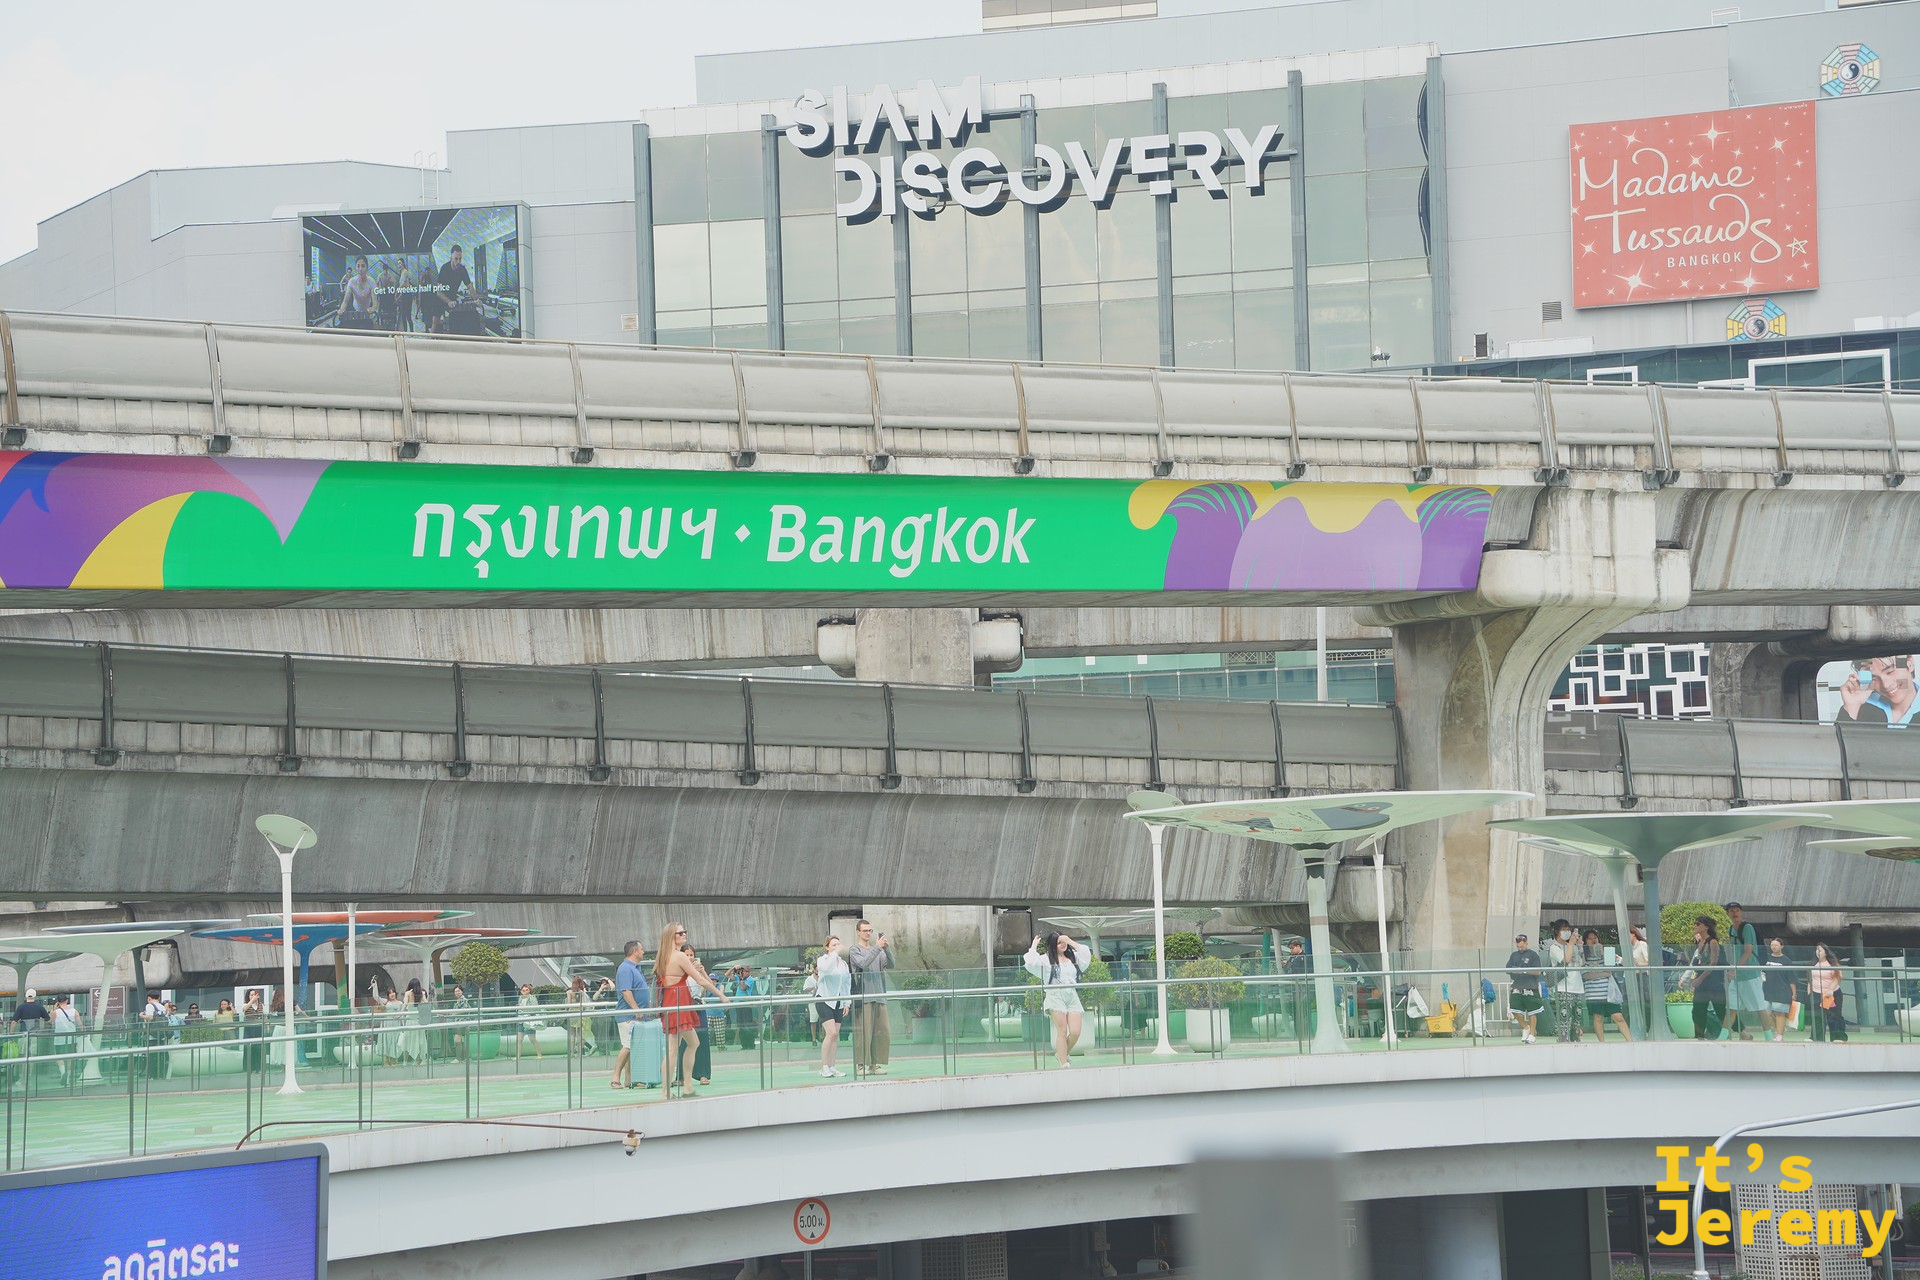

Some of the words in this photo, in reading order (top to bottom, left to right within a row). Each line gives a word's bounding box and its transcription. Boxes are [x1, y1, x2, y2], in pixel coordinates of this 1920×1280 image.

[786, 75, 982, 151] SIAM
[836, 124, 1280, 218] DISCOVERY
[1578, 147, 1755, 205] Madame
[1584, 193, 1782, 264] Tussauds
[1666, 251, 1742, 269] BANGKOK
[374, 287, 386, 295] Get
[387, 286, 395, 294] 10
[396, 285, 418, 294] weeks
[419, 284, 432, 293] half
[433, 283, 450, 294] price
[411, 503, 719, 579] กรุงเทพฯ
[767, 504, 1038, 578] Bangkok
[799, 1215, 817, 1228] 5.00
